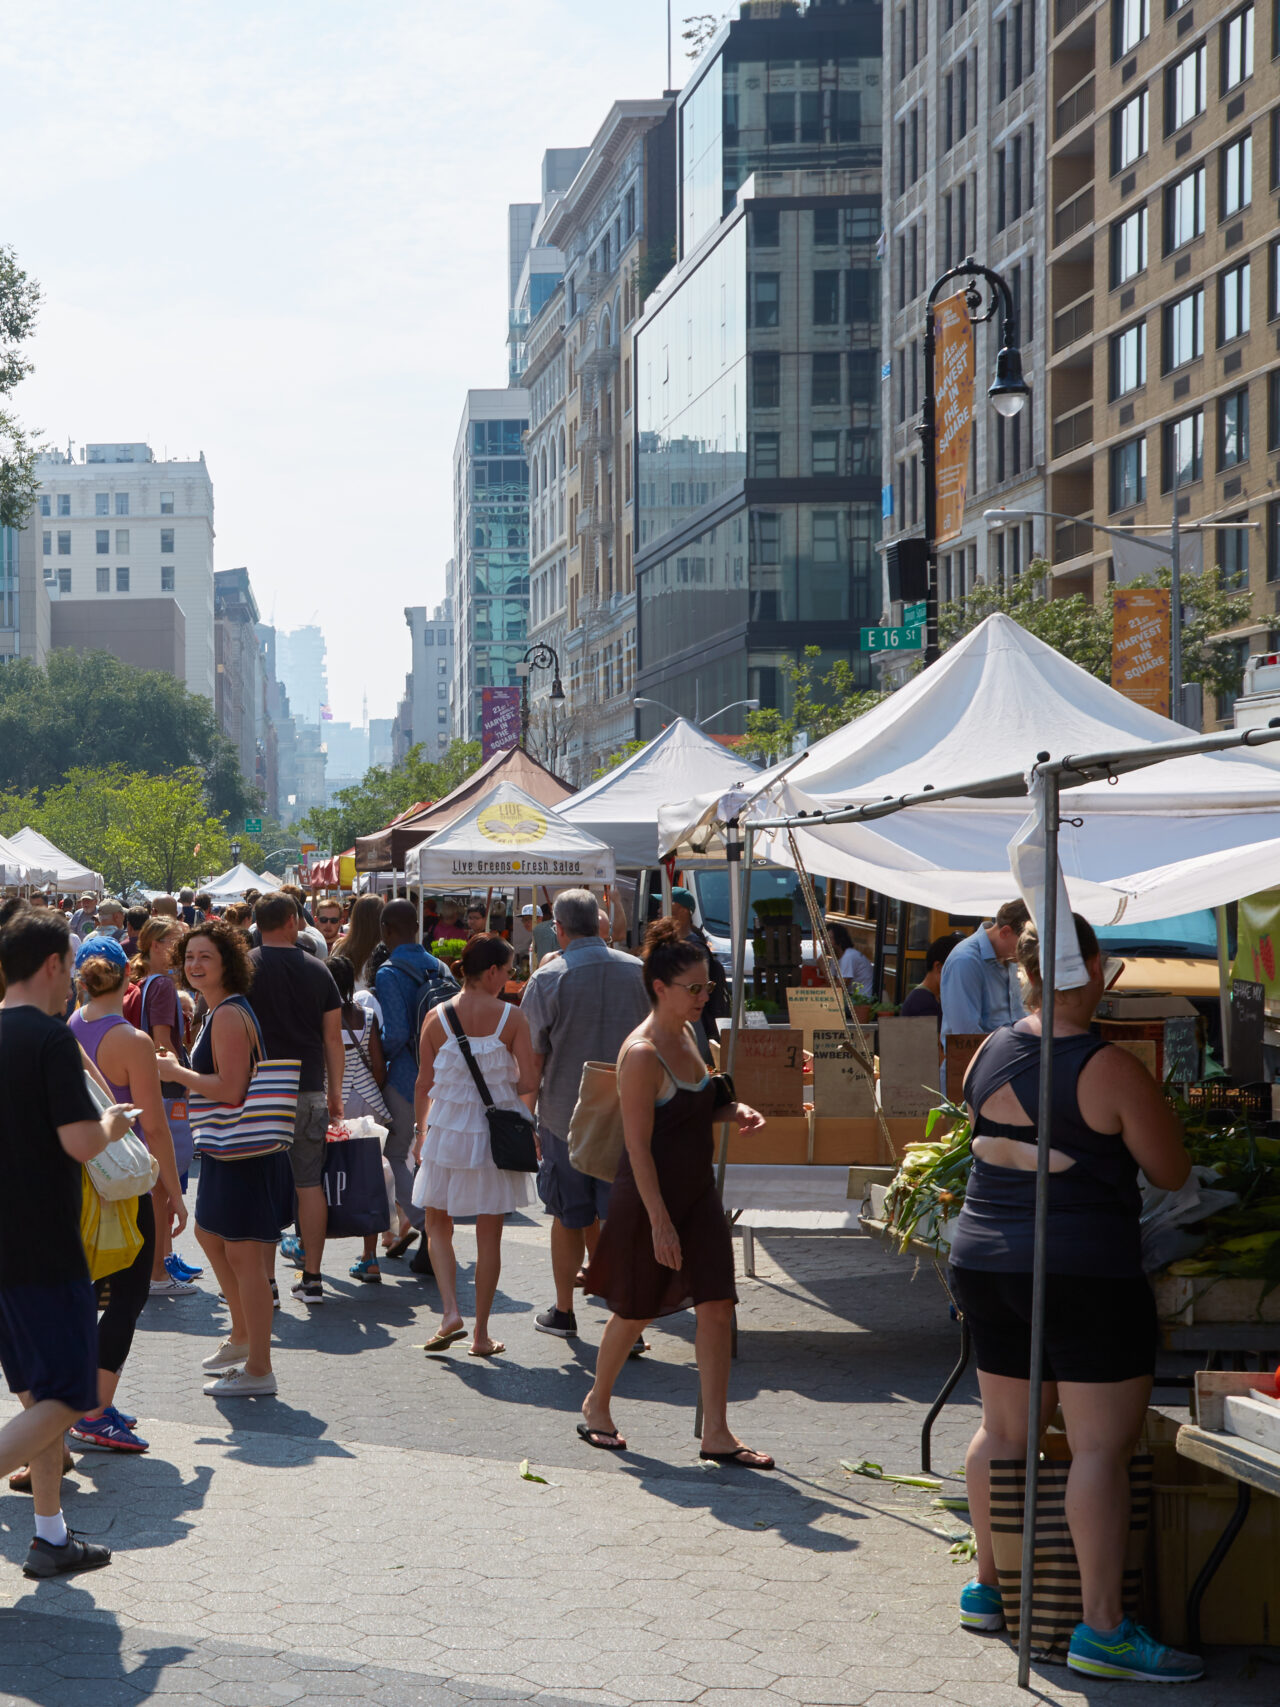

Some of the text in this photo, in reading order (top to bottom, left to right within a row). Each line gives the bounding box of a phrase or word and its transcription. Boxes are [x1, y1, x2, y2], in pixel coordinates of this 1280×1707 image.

[935, 353, 968, 408] HAVEST
[948, 383, 960, 403] IN
[943, 400, 960, 427] THE
[868, 629, 915, 647] E 16 St
[1116, 623, 1162, 652] HARVEST
[1139, 639, 1153, 652] IN
[1131, 650, 1154, 666] THE
[1124, 655, 1166, 681] SQUARE
[484, 711, 515, 730] HARVEST
[500, 721, 509, 730] IN
[490, 732, 518, 750] SQUARE
[495, 728, 510, 739] THE
[453, 860, 581, 872] Live Greens Fresh Salad
[323, 1171, 347, 1206] AP
